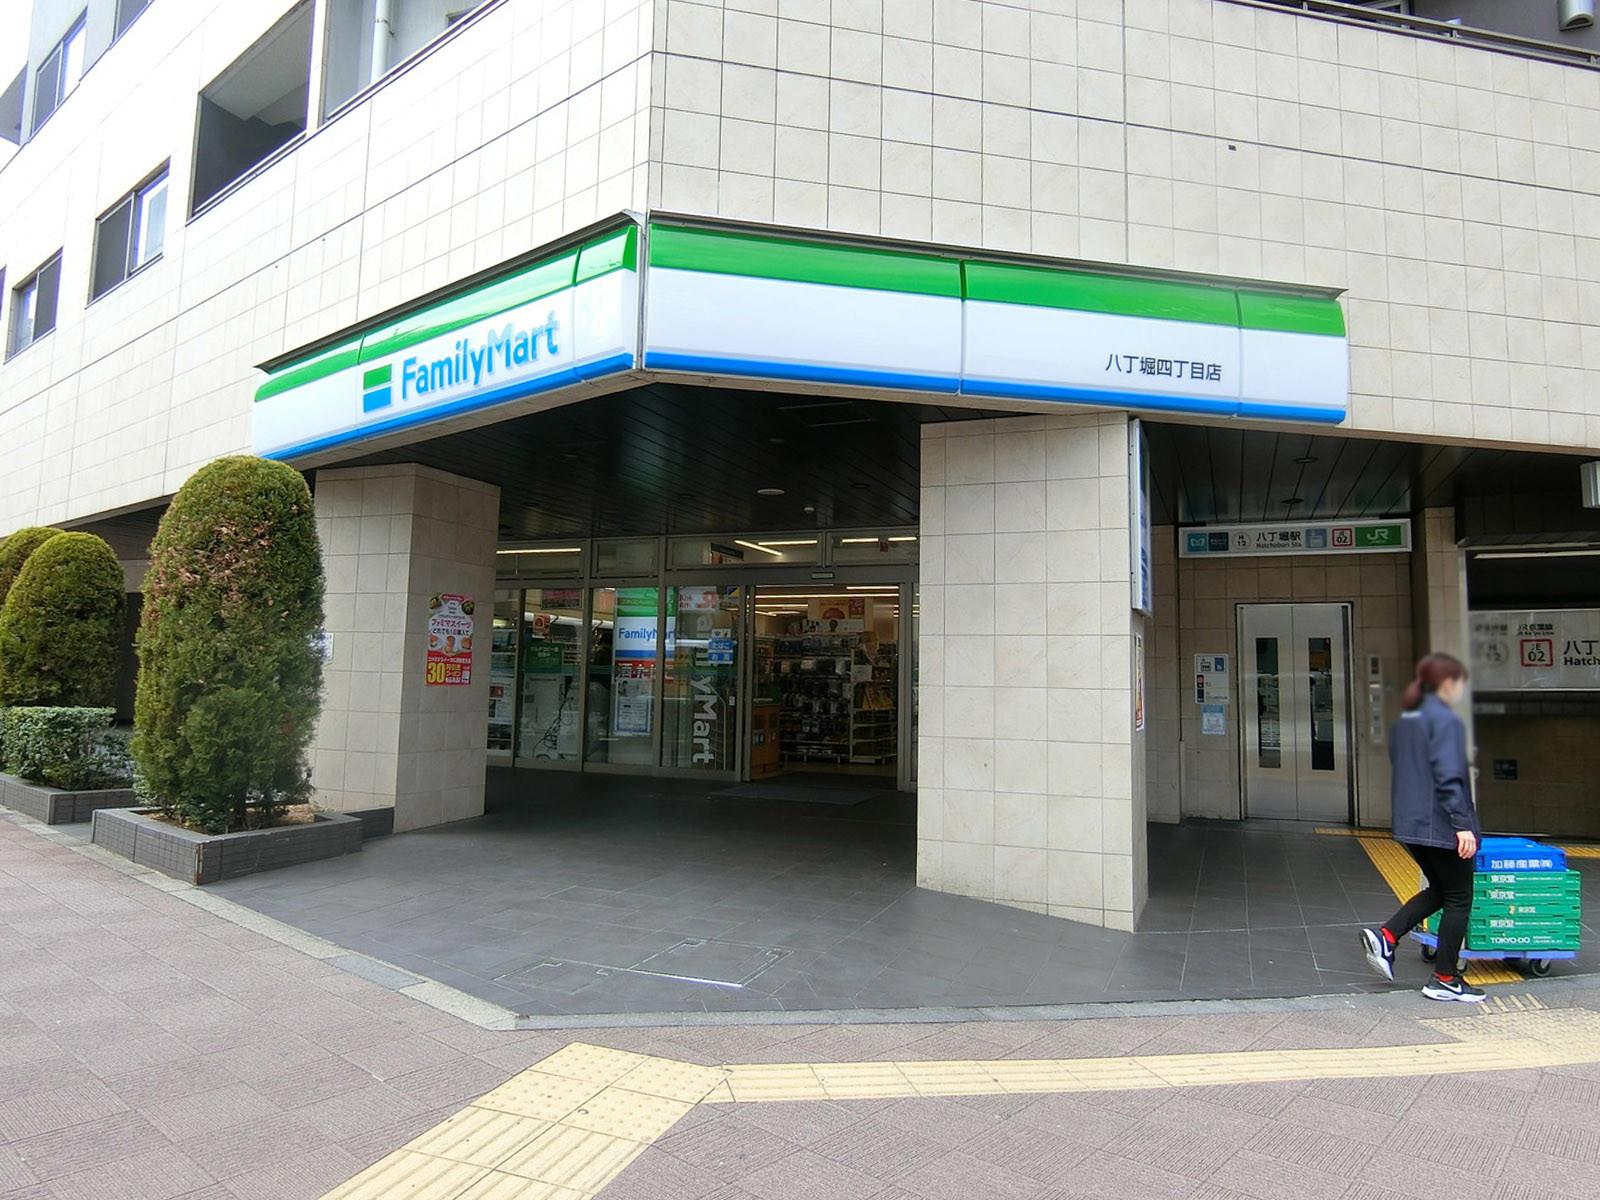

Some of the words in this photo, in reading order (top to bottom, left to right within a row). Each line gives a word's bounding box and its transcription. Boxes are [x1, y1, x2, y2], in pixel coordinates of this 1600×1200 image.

[402, 311, 560, 400] FamilyMart
[1105, 353, 1222, 382] 八丁堀四丁目店
[1256, 531, 1301, 542] 八丁堀駅
[1336, 536, 1348, 544] 02
[1367, 529, 1388, 540] JR
[1563, 640, 1600, 656] 八丁
[1527, 651, 1545, 662] 02
[427, 662, 446, 683] 30
